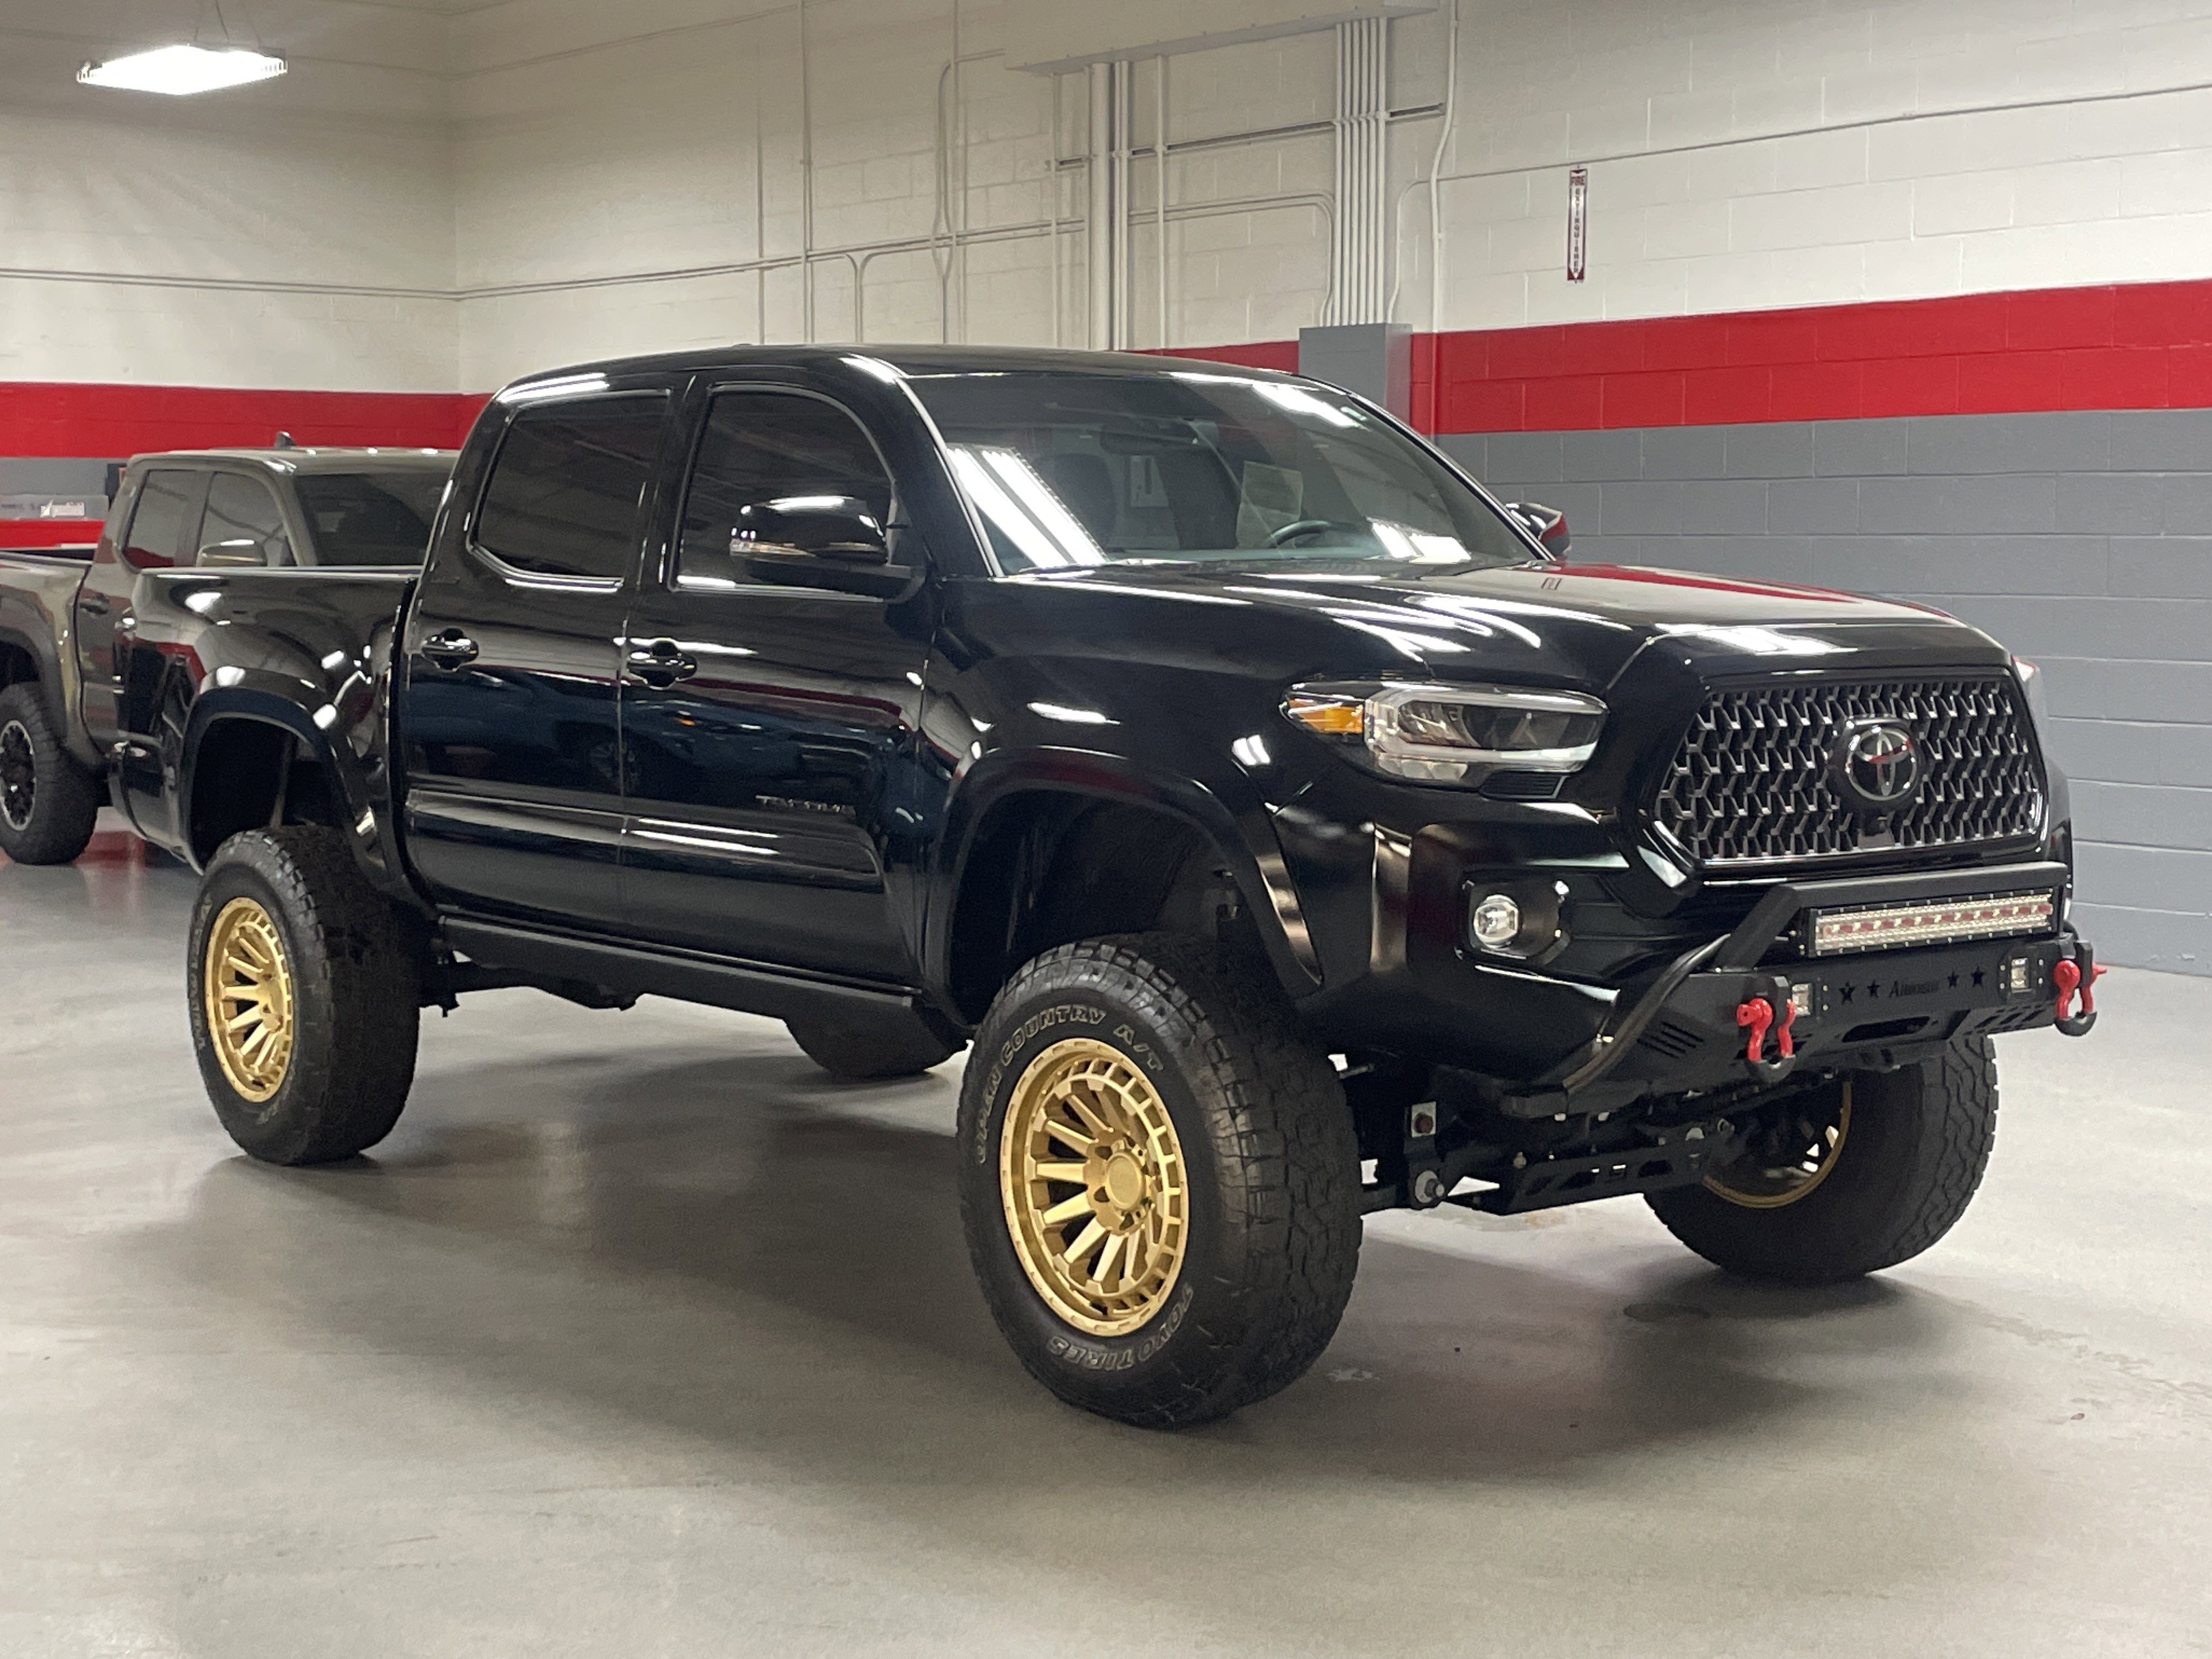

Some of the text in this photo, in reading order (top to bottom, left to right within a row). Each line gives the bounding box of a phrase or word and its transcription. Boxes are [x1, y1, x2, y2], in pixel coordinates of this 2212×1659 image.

[1000, 1004, 1108, 1067] COUNTRY
[1045, 1282, 1194, 1371] TOYO TIRES
